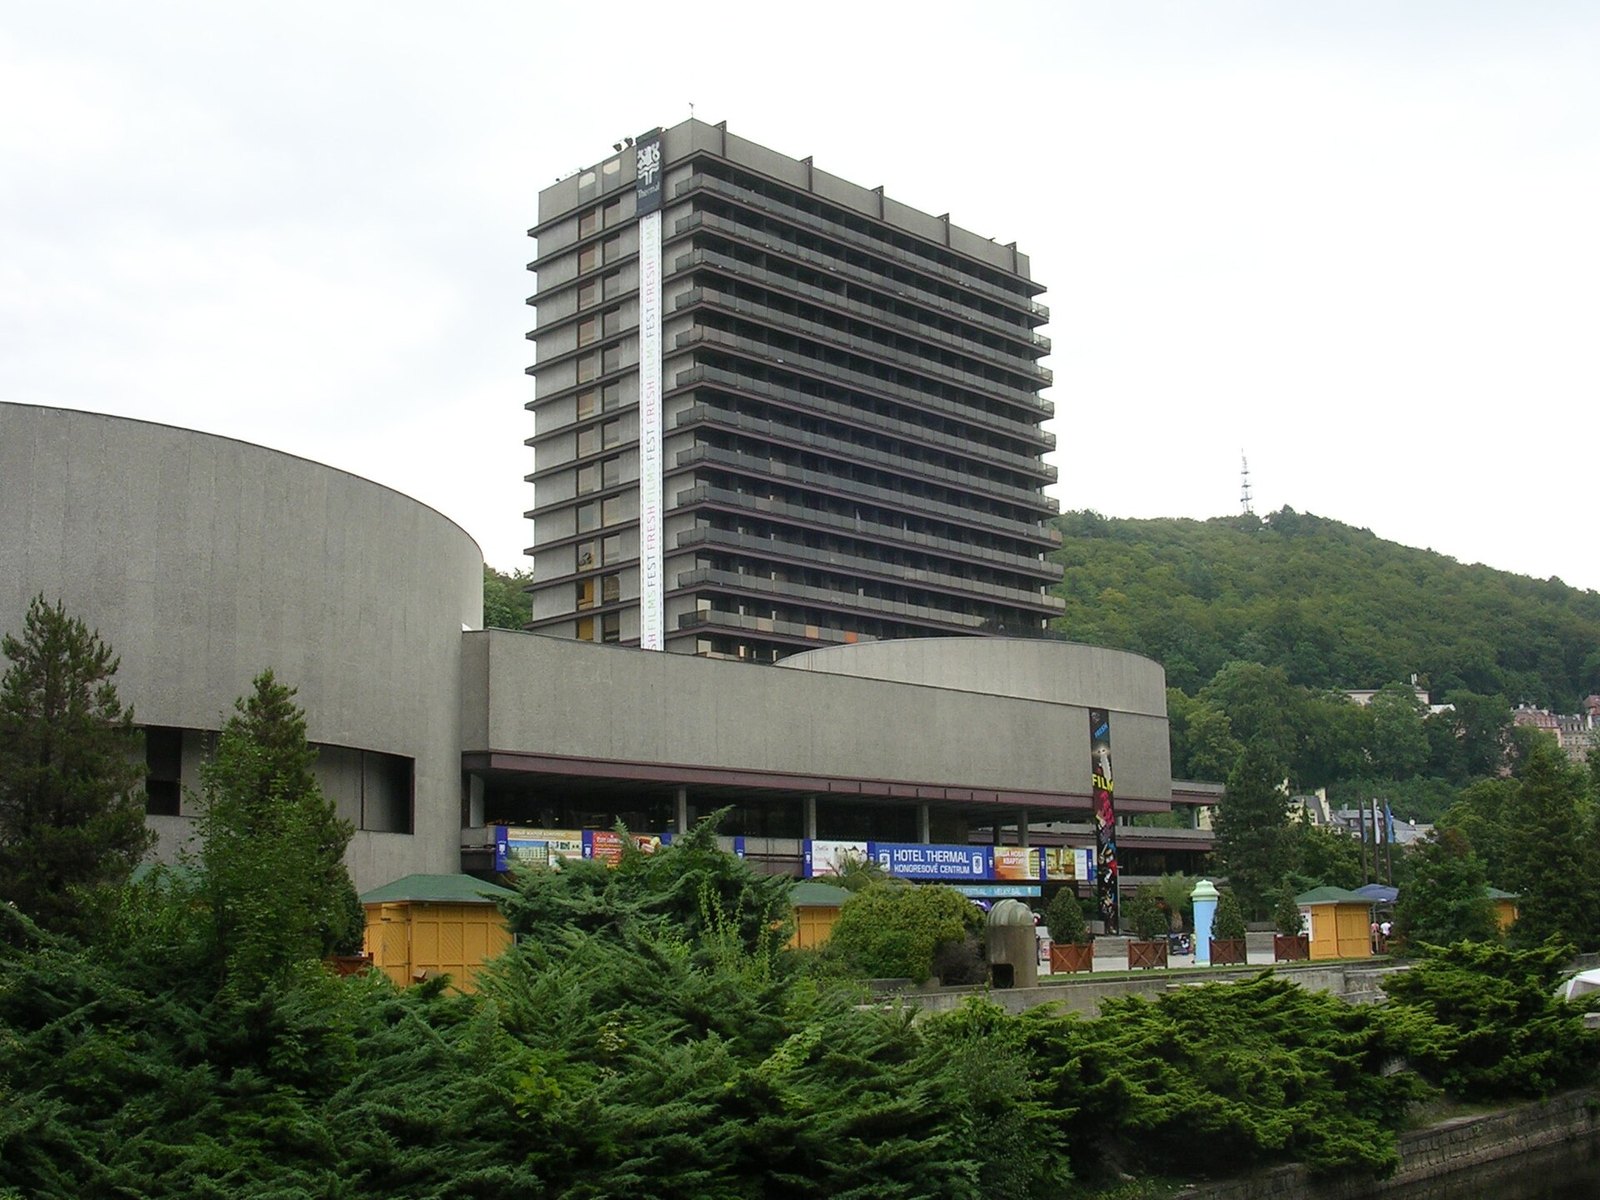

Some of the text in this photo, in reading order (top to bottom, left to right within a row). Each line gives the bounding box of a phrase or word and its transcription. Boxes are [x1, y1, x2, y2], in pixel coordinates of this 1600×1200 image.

[646, 261, 655, 303] FRESH
[646, 307, 655, 338] FEST
[646, 381, 656, 425] FRESH
[646, 429, 656, 461] FEST
[647, 505, 656, 550] FRESH
[647, 554, 656, 587] FEST
[1092, 774, 1114, 792] FILM
[894, 849, 969, 864] HOTEL THERMAL
[894, 863, 970, 875] KONGRESOVÉ CENTRUM
